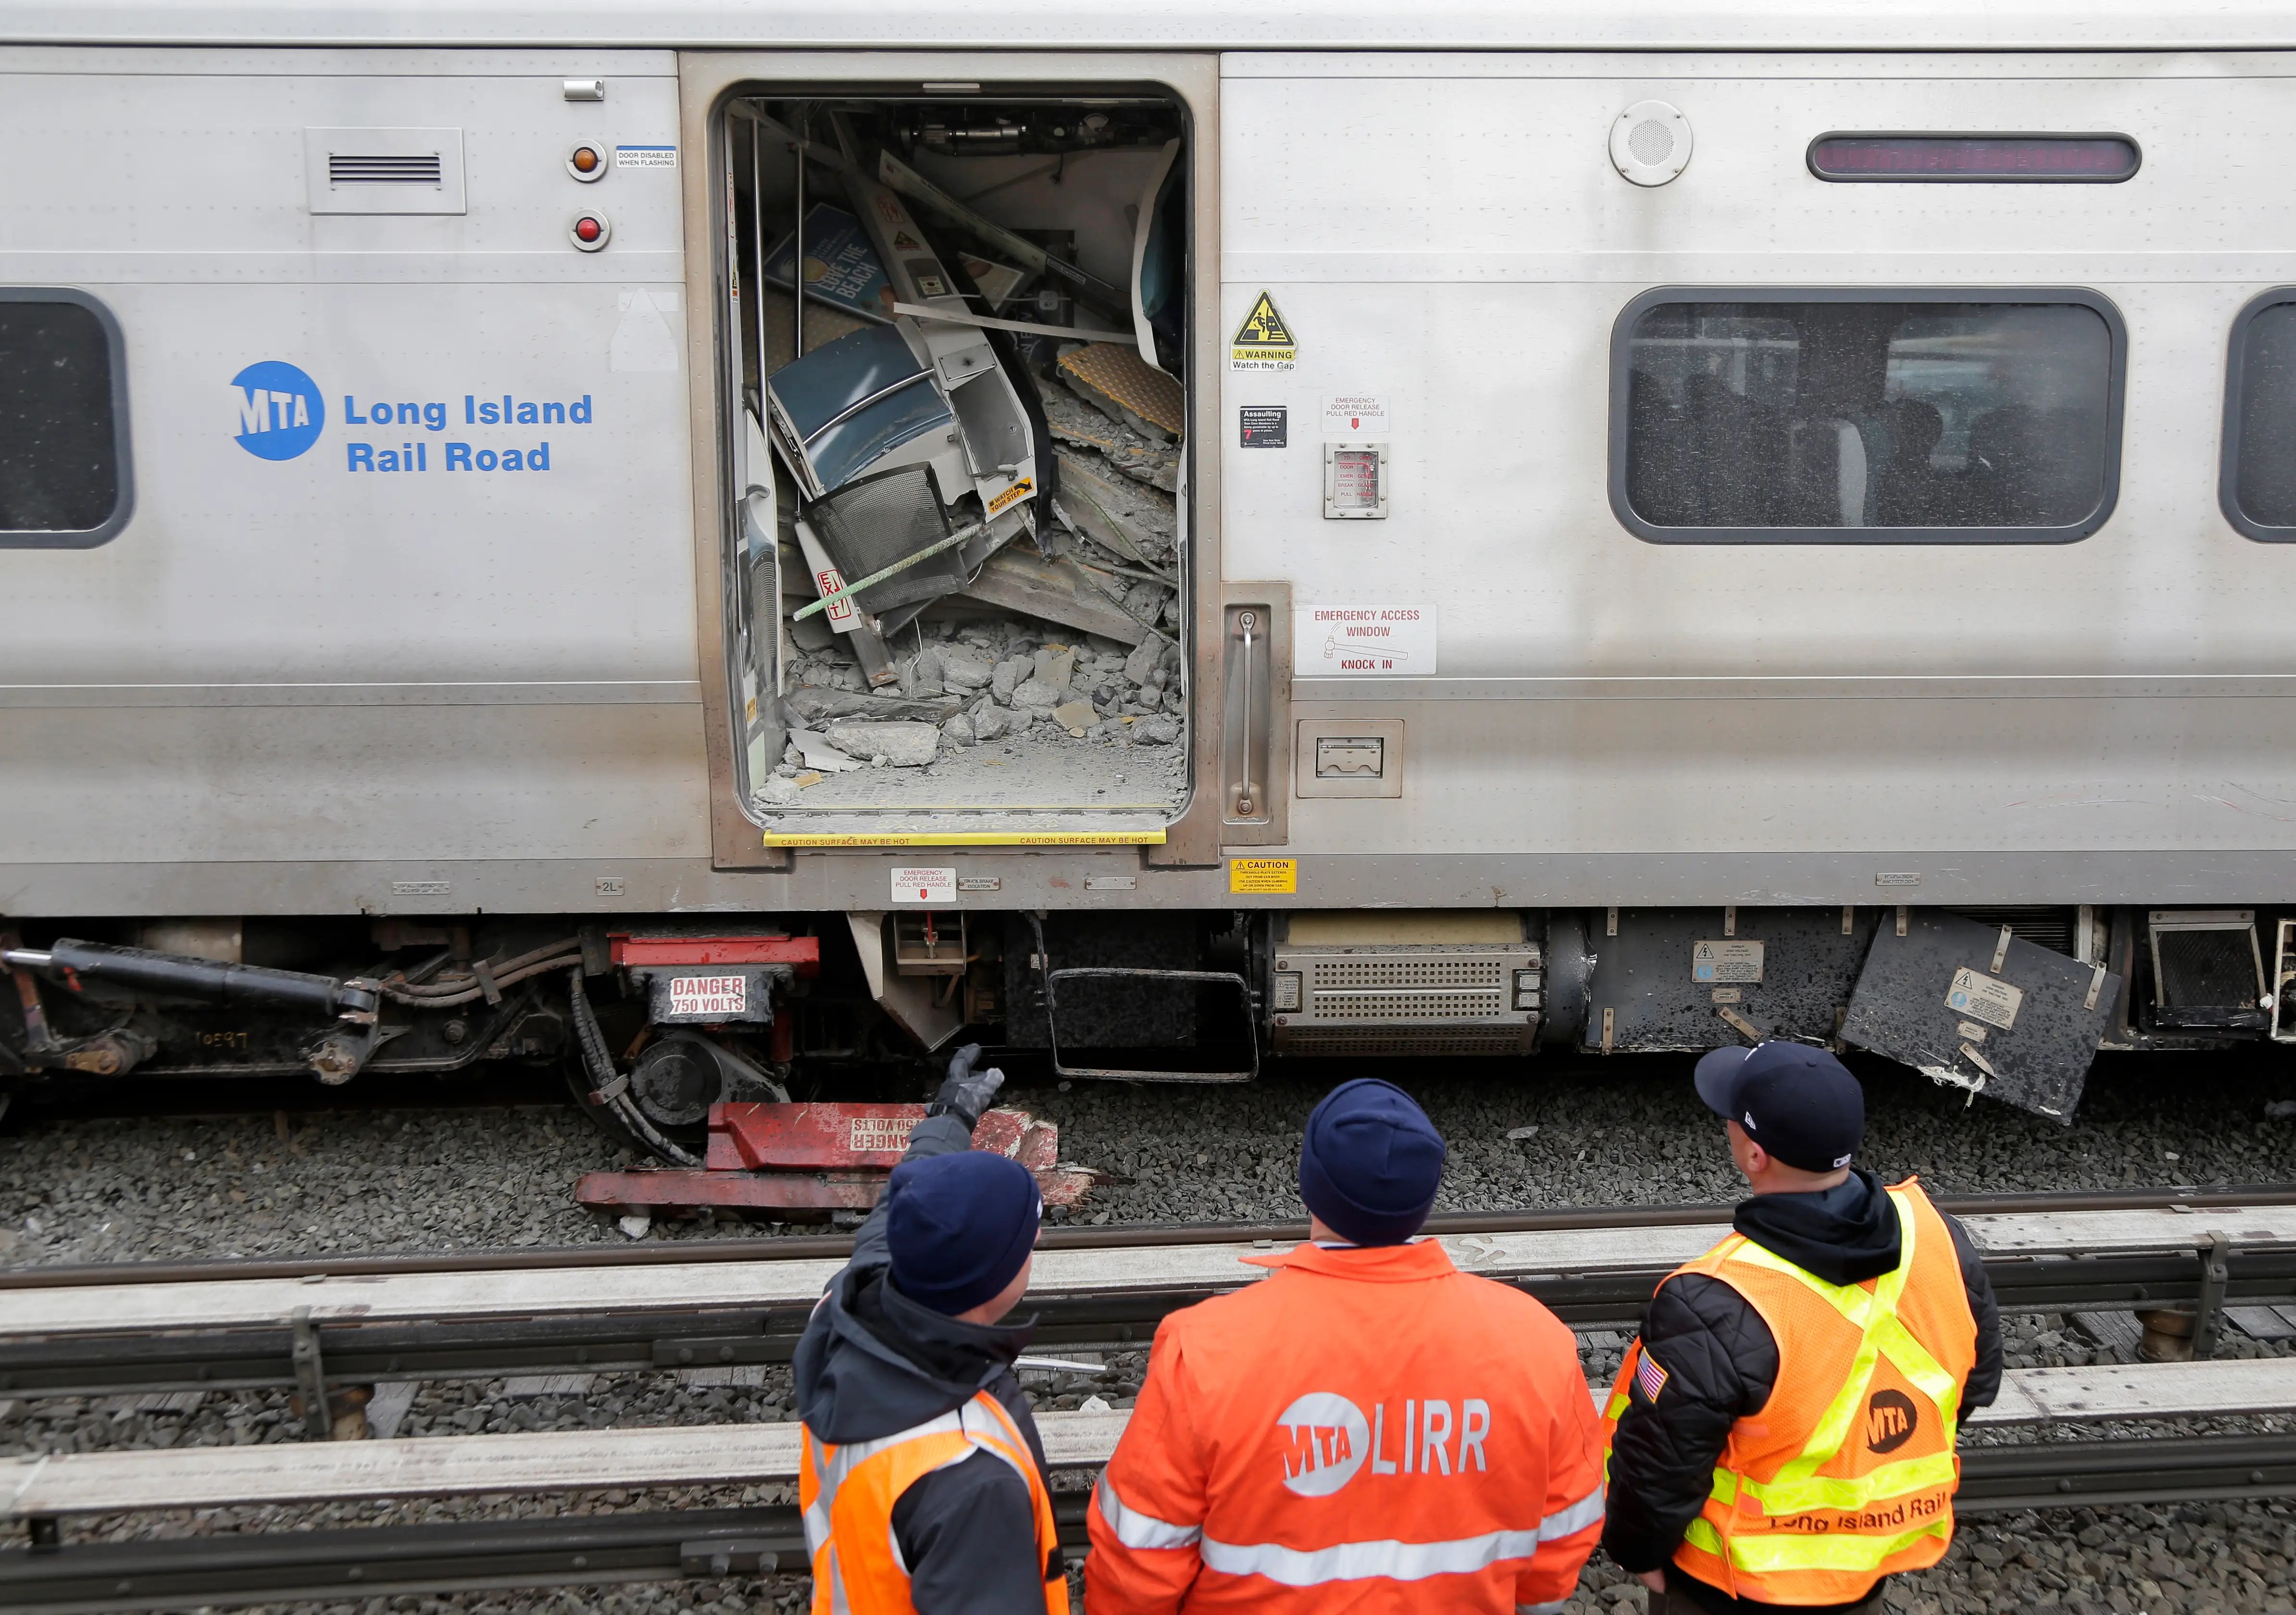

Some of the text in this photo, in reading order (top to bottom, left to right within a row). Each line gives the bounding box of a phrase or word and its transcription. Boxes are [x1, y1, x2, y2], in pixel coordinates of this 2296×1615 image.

[817, 243, 868, 291] LOVE THE
[836, 261, 878, 299] BEACH
[1277, 361, 1294, 370] Gap
[344, 395, 592, 431] Long Island
[1244, 429, 1253, 439] 7
[347, 442, 550, 472] Rail Road
[991, 490, 1020, 511] YOUR STEP
[994, 488, 1013, 504] WATCH
[820, 573, 838, 617] EXT
[1314, 610, 1420, 621] EMERGENCY ACCESS
[1346, 626, 1390, 636] WINDOW
[1341, 659, 1392, 669] KNOCK IN
[603, 882, 617, 891] 2L
[674, 978, 742, 995] DANGER
[674, 997, 743, 1012] 750 VOLTS
[854, 1119, 919, 1131] 50 VOLTS
[854, 1134, 909, 1149] ANGER
[1372, 1399, 1490, 1476] LIRR
[1838, 1504, 1905, 1529] Island
